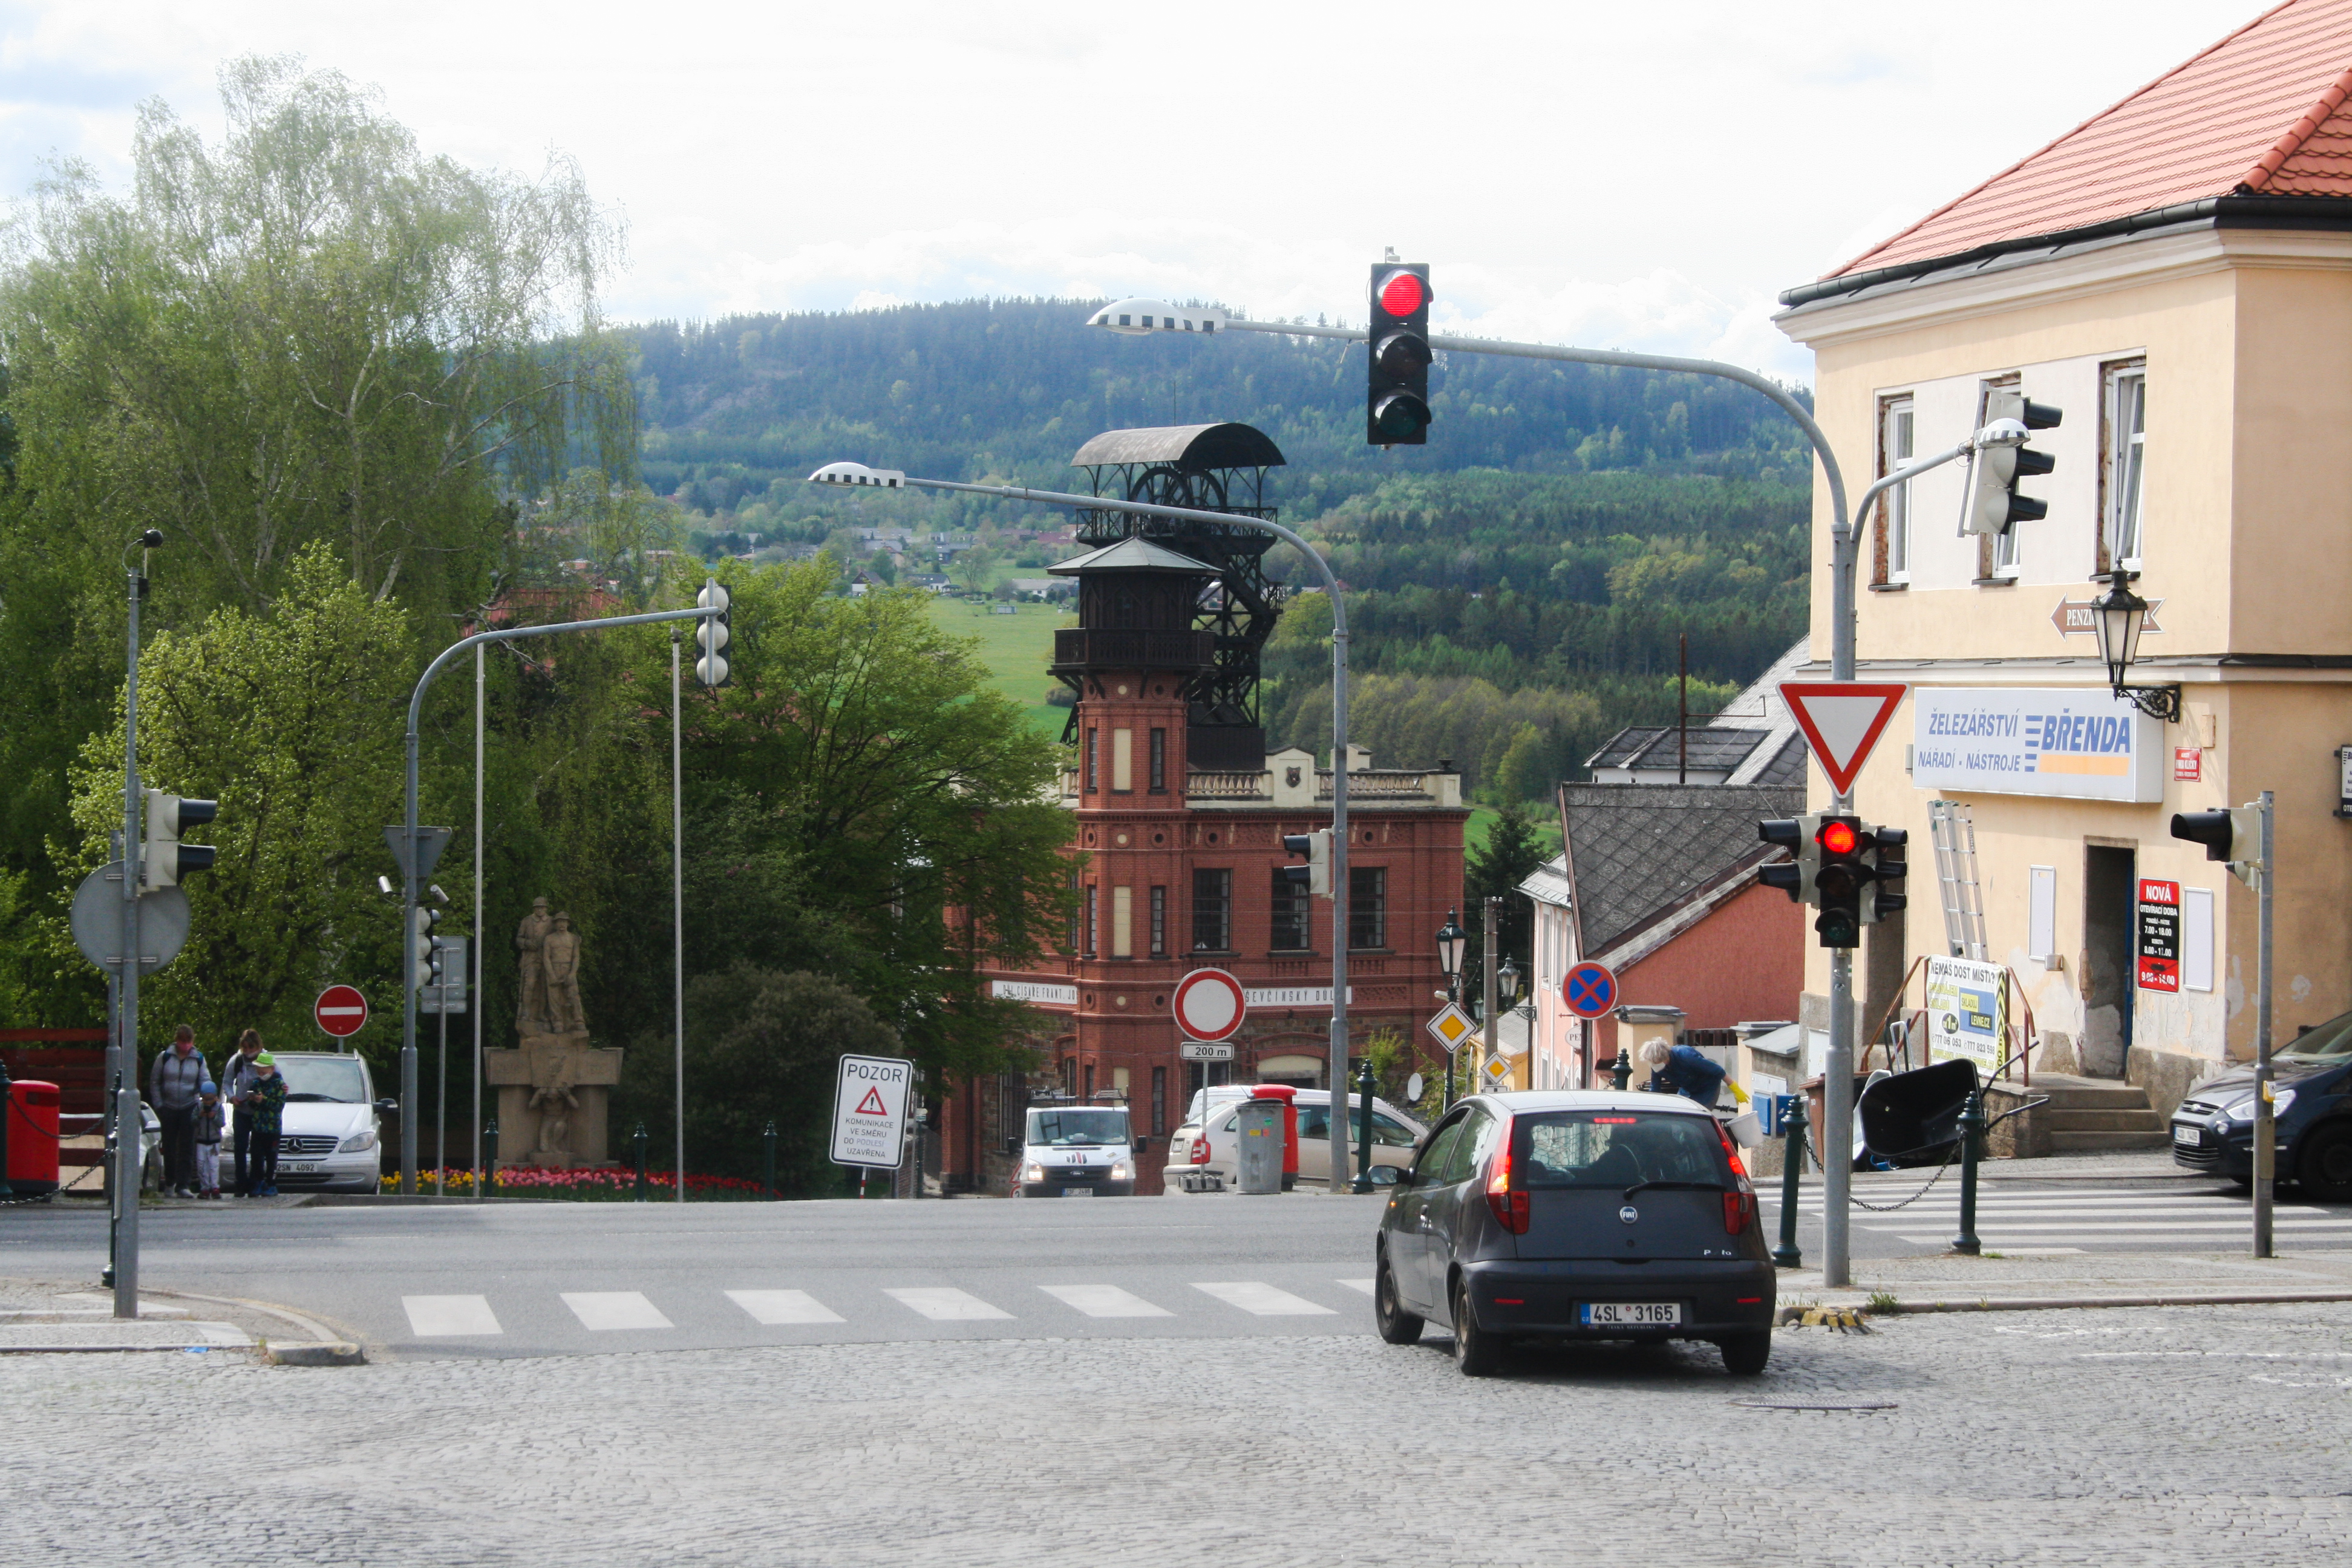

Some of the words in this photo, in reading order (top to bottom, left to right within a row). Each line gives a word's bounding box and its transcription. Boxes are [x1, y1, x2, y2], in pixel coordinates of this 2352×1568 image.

[1929, 708, 2020, 737] ŽELEZÁŘSTVÍ
[2041, 708, 2131, 753] BŘENDA
[1918, 747, 1956, 768] NÁŘADÍ
[1965, 750, 2020, 772] NÁSTROJE
[2146, 883, 2172, 901] NOVÁ
[2140, 904, 2163, 914] OTEVÍRACÍ
[2163, 907, 2178, 916] DOBA
[2145, 926, 2155, 935] 7.00
[1954, 964, 1970, 979] DOST
[1316, 988, 1333, 1001] DŮL
[1195, 1047, 1214, 1056] 200
[847, 1063, 903, 1082] POZOR
[845, 1117, 894, 1128] KOMUNIKACE
[861, 1128, 887, 1137] SMĚRU
[856, 1138, 884, 1147] PODLESÍ
[846, 1148, 886, 1158] UZAVŘENA
[1594, 1305, 1622, 1321] 4SL
[1635, 1305, 1673, 1321] 3165
